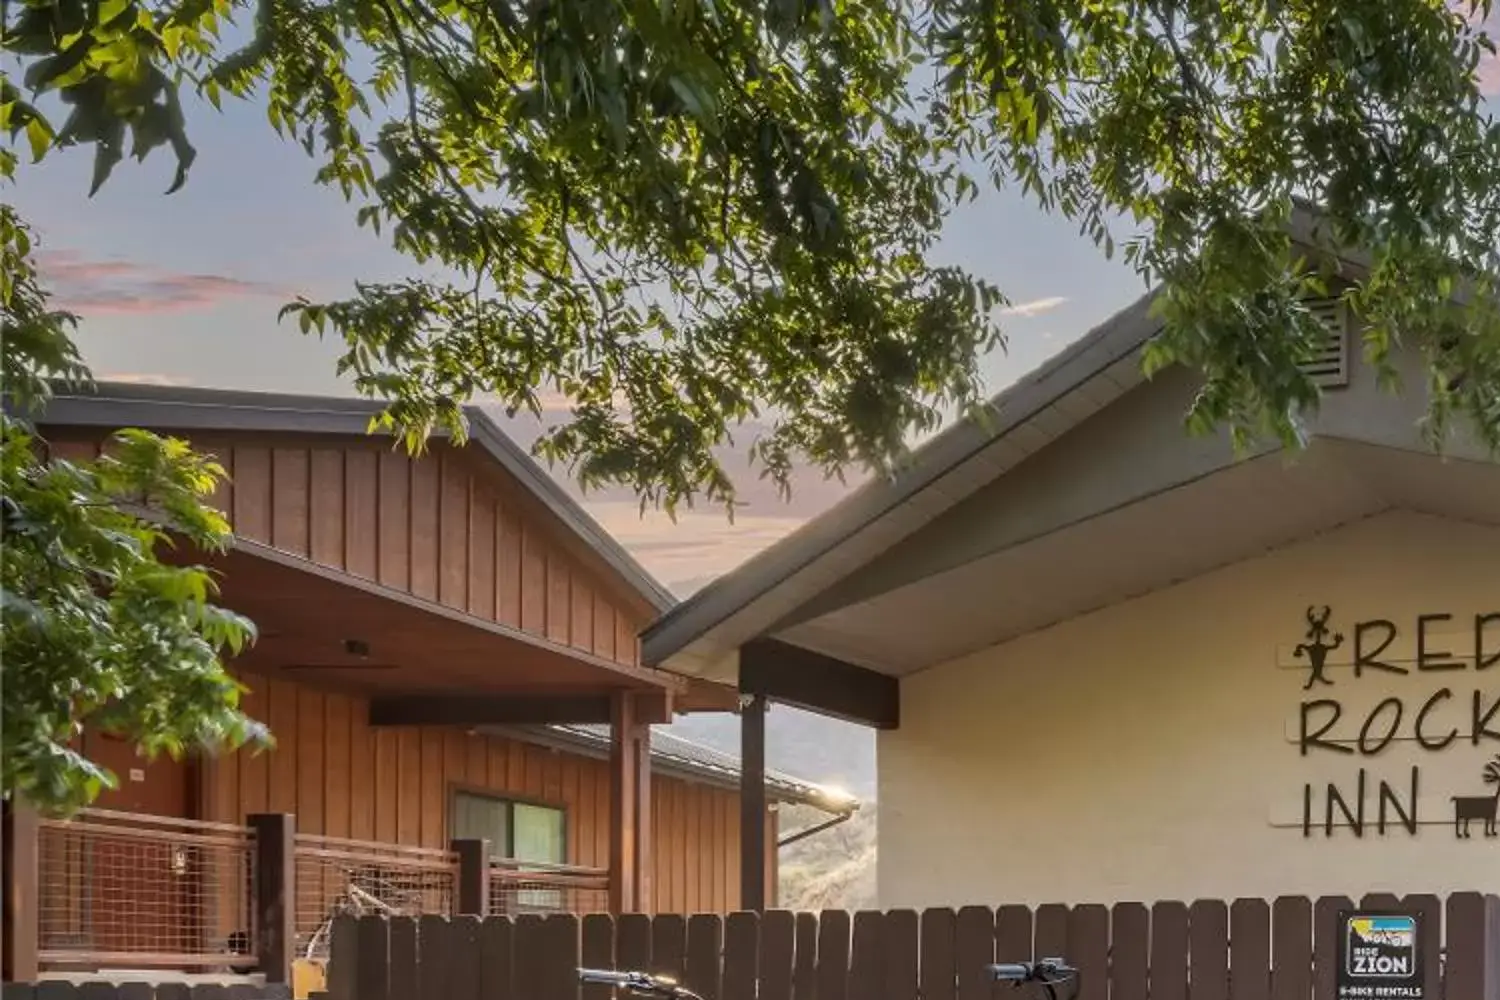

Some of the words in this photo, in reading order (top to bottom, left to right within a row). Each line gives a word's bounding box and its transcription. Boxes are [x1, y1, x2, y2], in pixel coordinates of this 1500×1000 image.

[1303, 765, 1419, 838] INN
[1353, 956, 1407, 973] ZION
[1375, 987, 1422, 997] RENTALS
